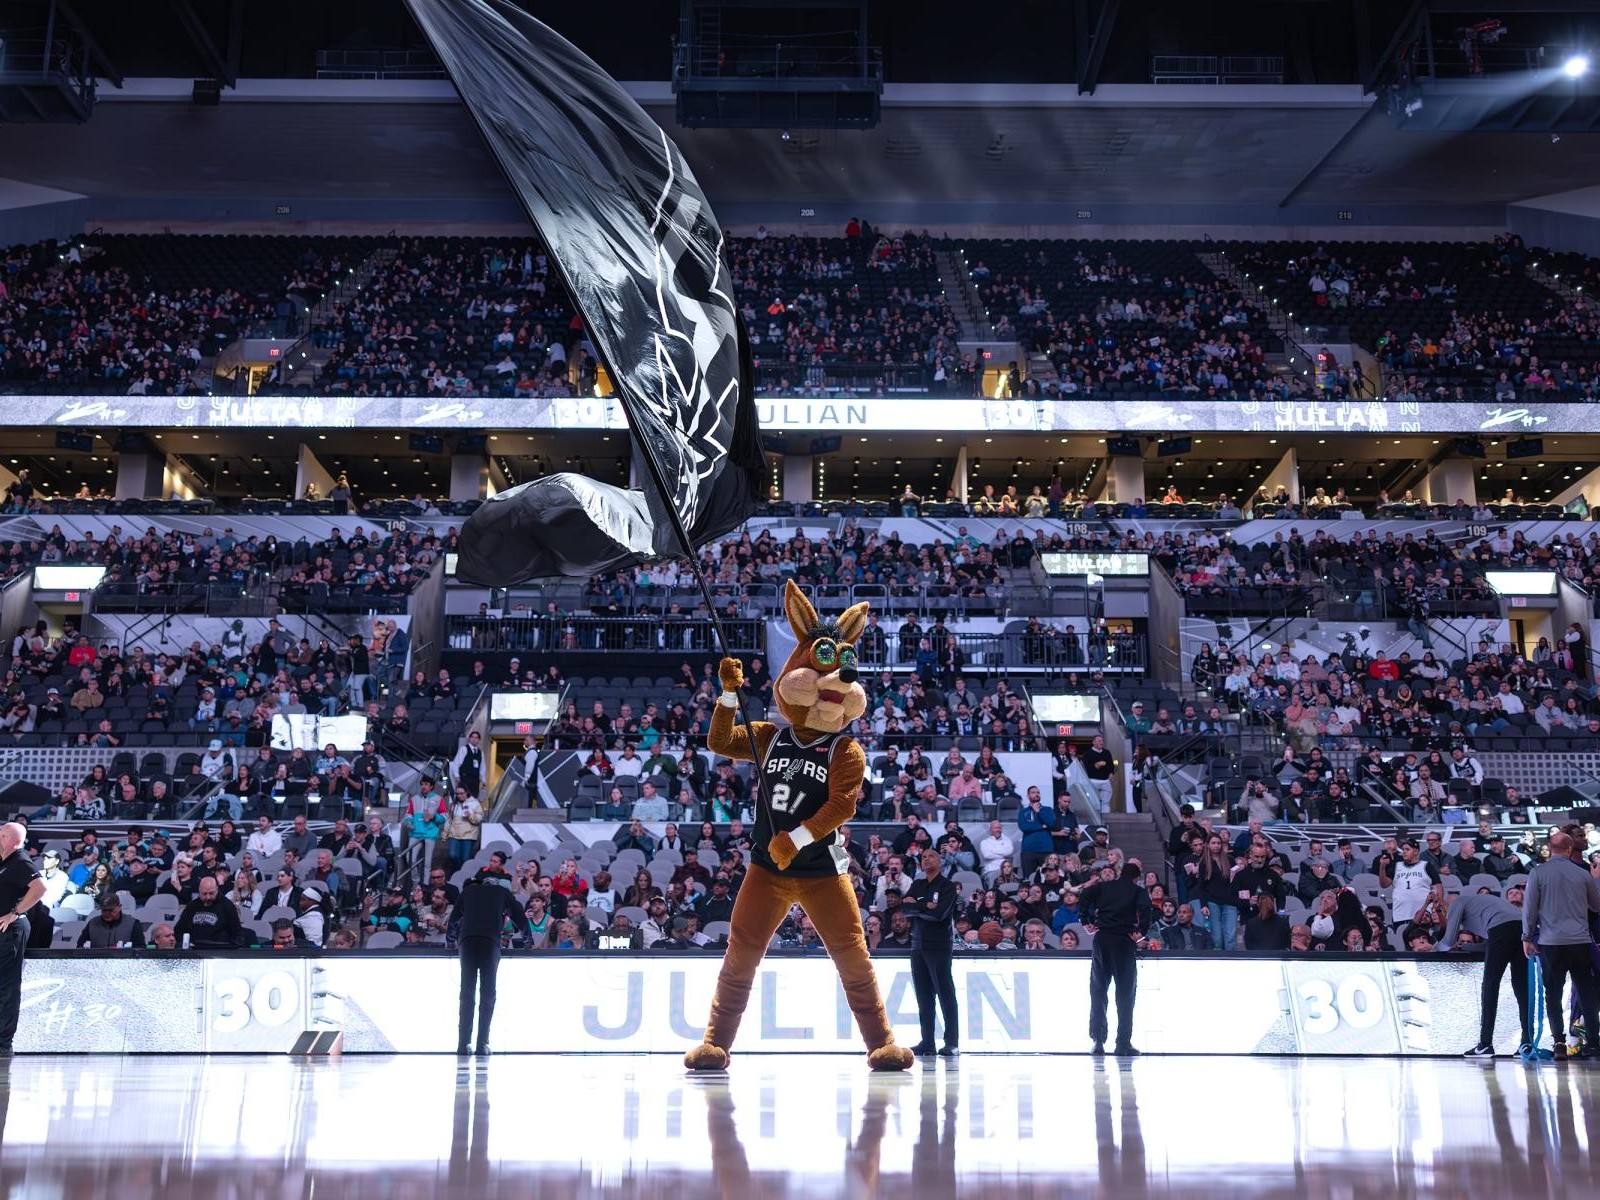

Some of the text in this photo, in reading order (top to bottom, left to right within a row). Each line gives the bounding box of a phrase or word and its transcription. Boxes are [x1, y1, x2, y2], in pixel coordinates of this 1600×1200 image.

[756, 405, 867, 424] ULIAN
[1275, 407, 1388, 427] JULIAN
[386, 521, 407, 532] 106
[1467, 525, 1487, 537] 109
[1059, 725, 1072, 735] EXIT
[767, 758, 828, 783] SPURS
[772, 783, 806, 815] 21
[1406, 880, 1411, 890] 1
[211, 971, 299, 1033] 30
[582, 971, 1033, 1041] JULIAN
[1297, 973, 1384, 1034] 30
